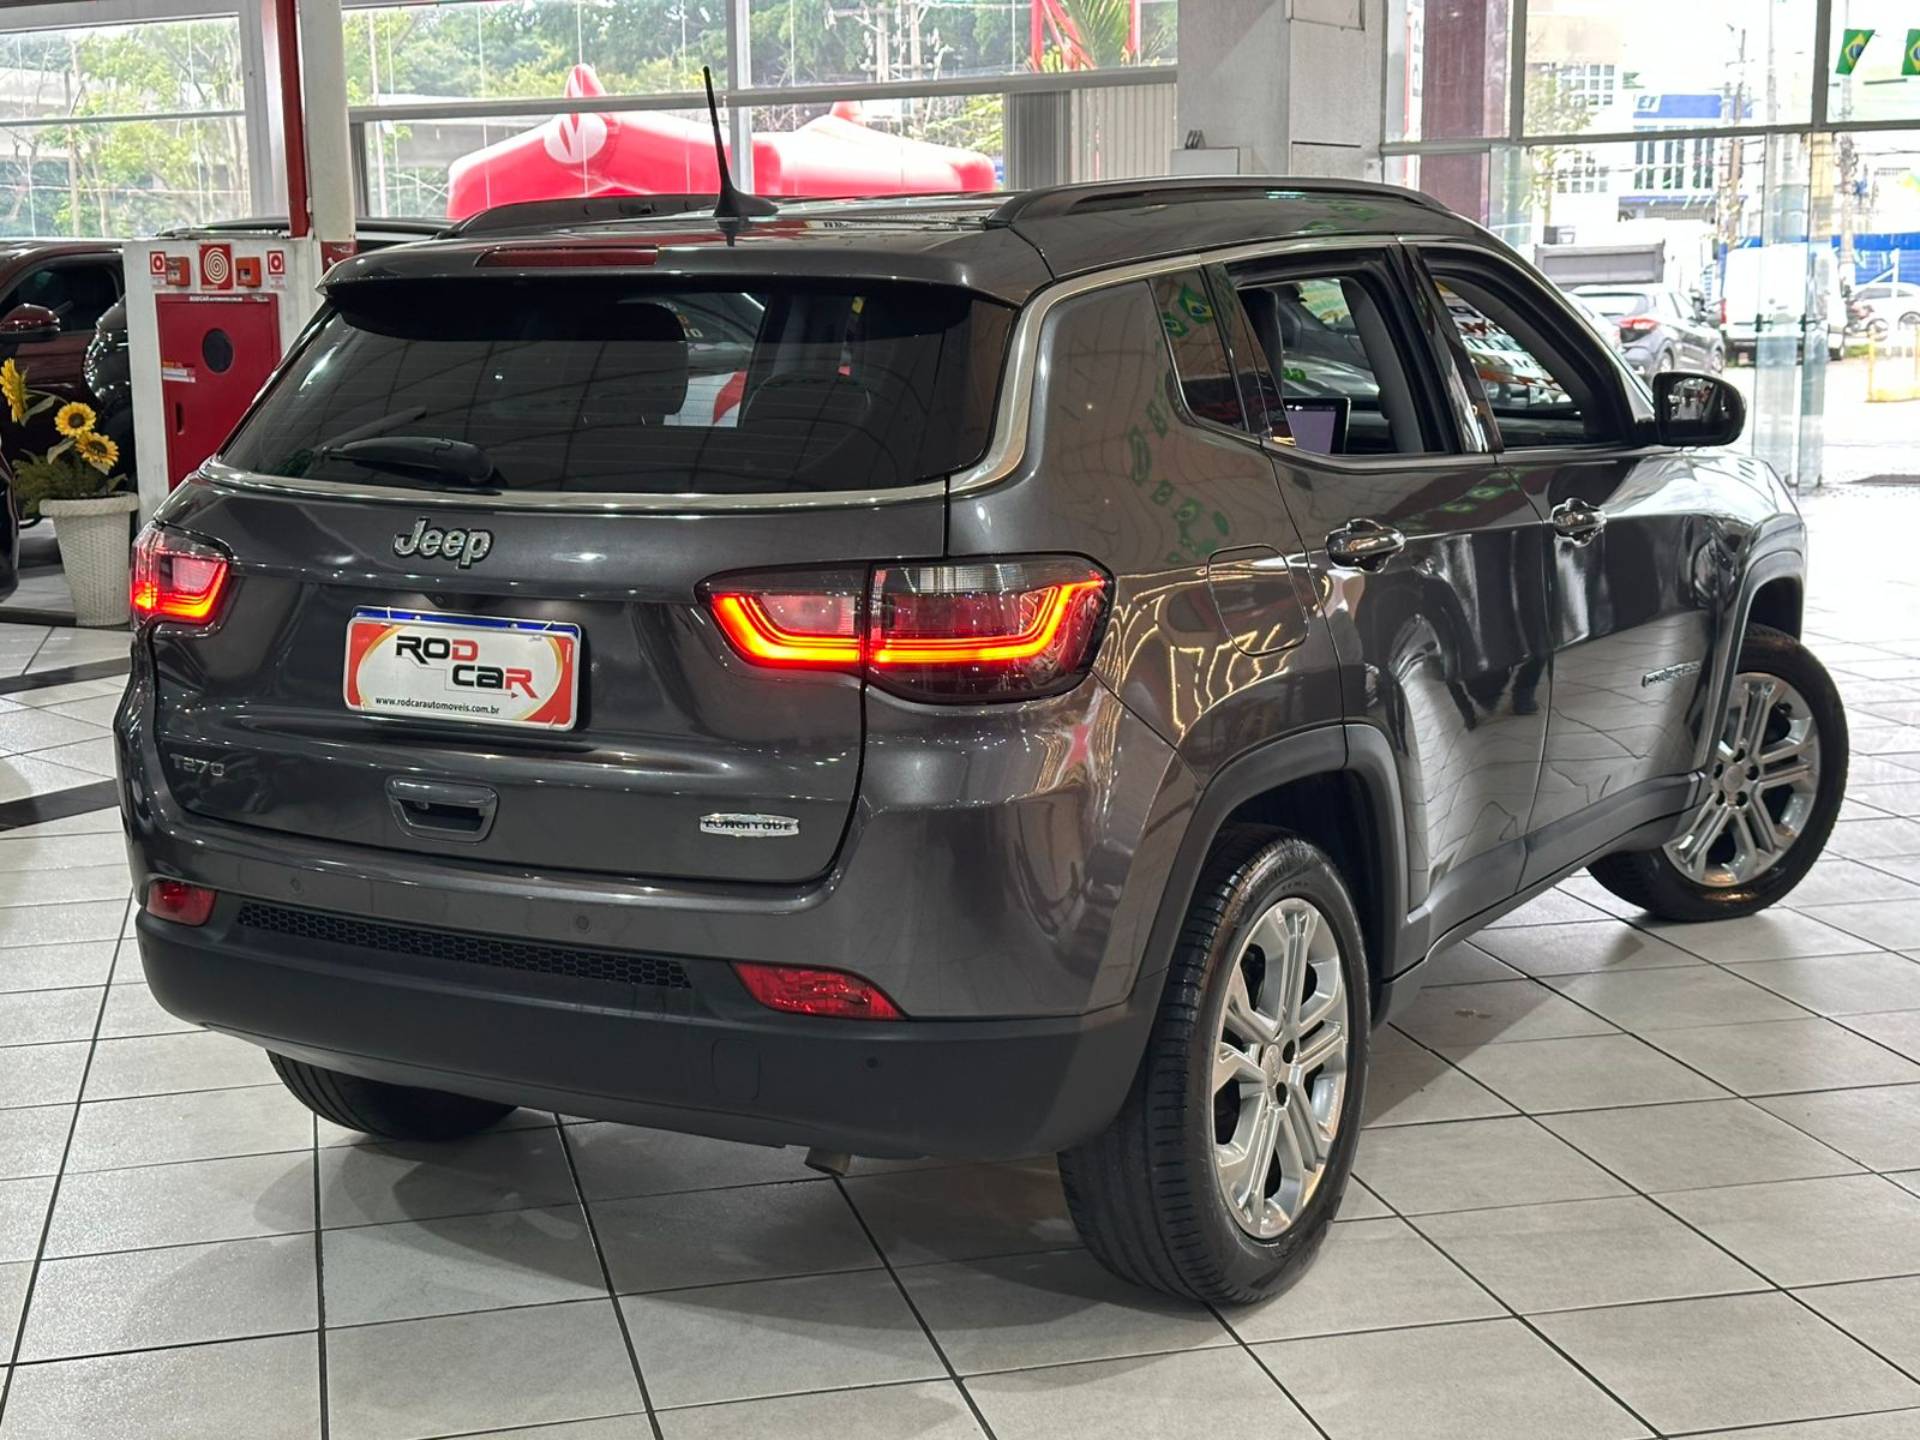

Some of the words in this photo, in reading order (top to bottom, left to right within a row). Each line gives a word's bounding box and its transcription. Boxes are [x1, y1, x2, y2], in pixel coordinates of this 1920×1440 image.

[394, 519, 492, 567] Jeep
[396, 635, 479, 665] ROD
[375, 697, 500, 714] www.rodcarautomoveis.com.br
